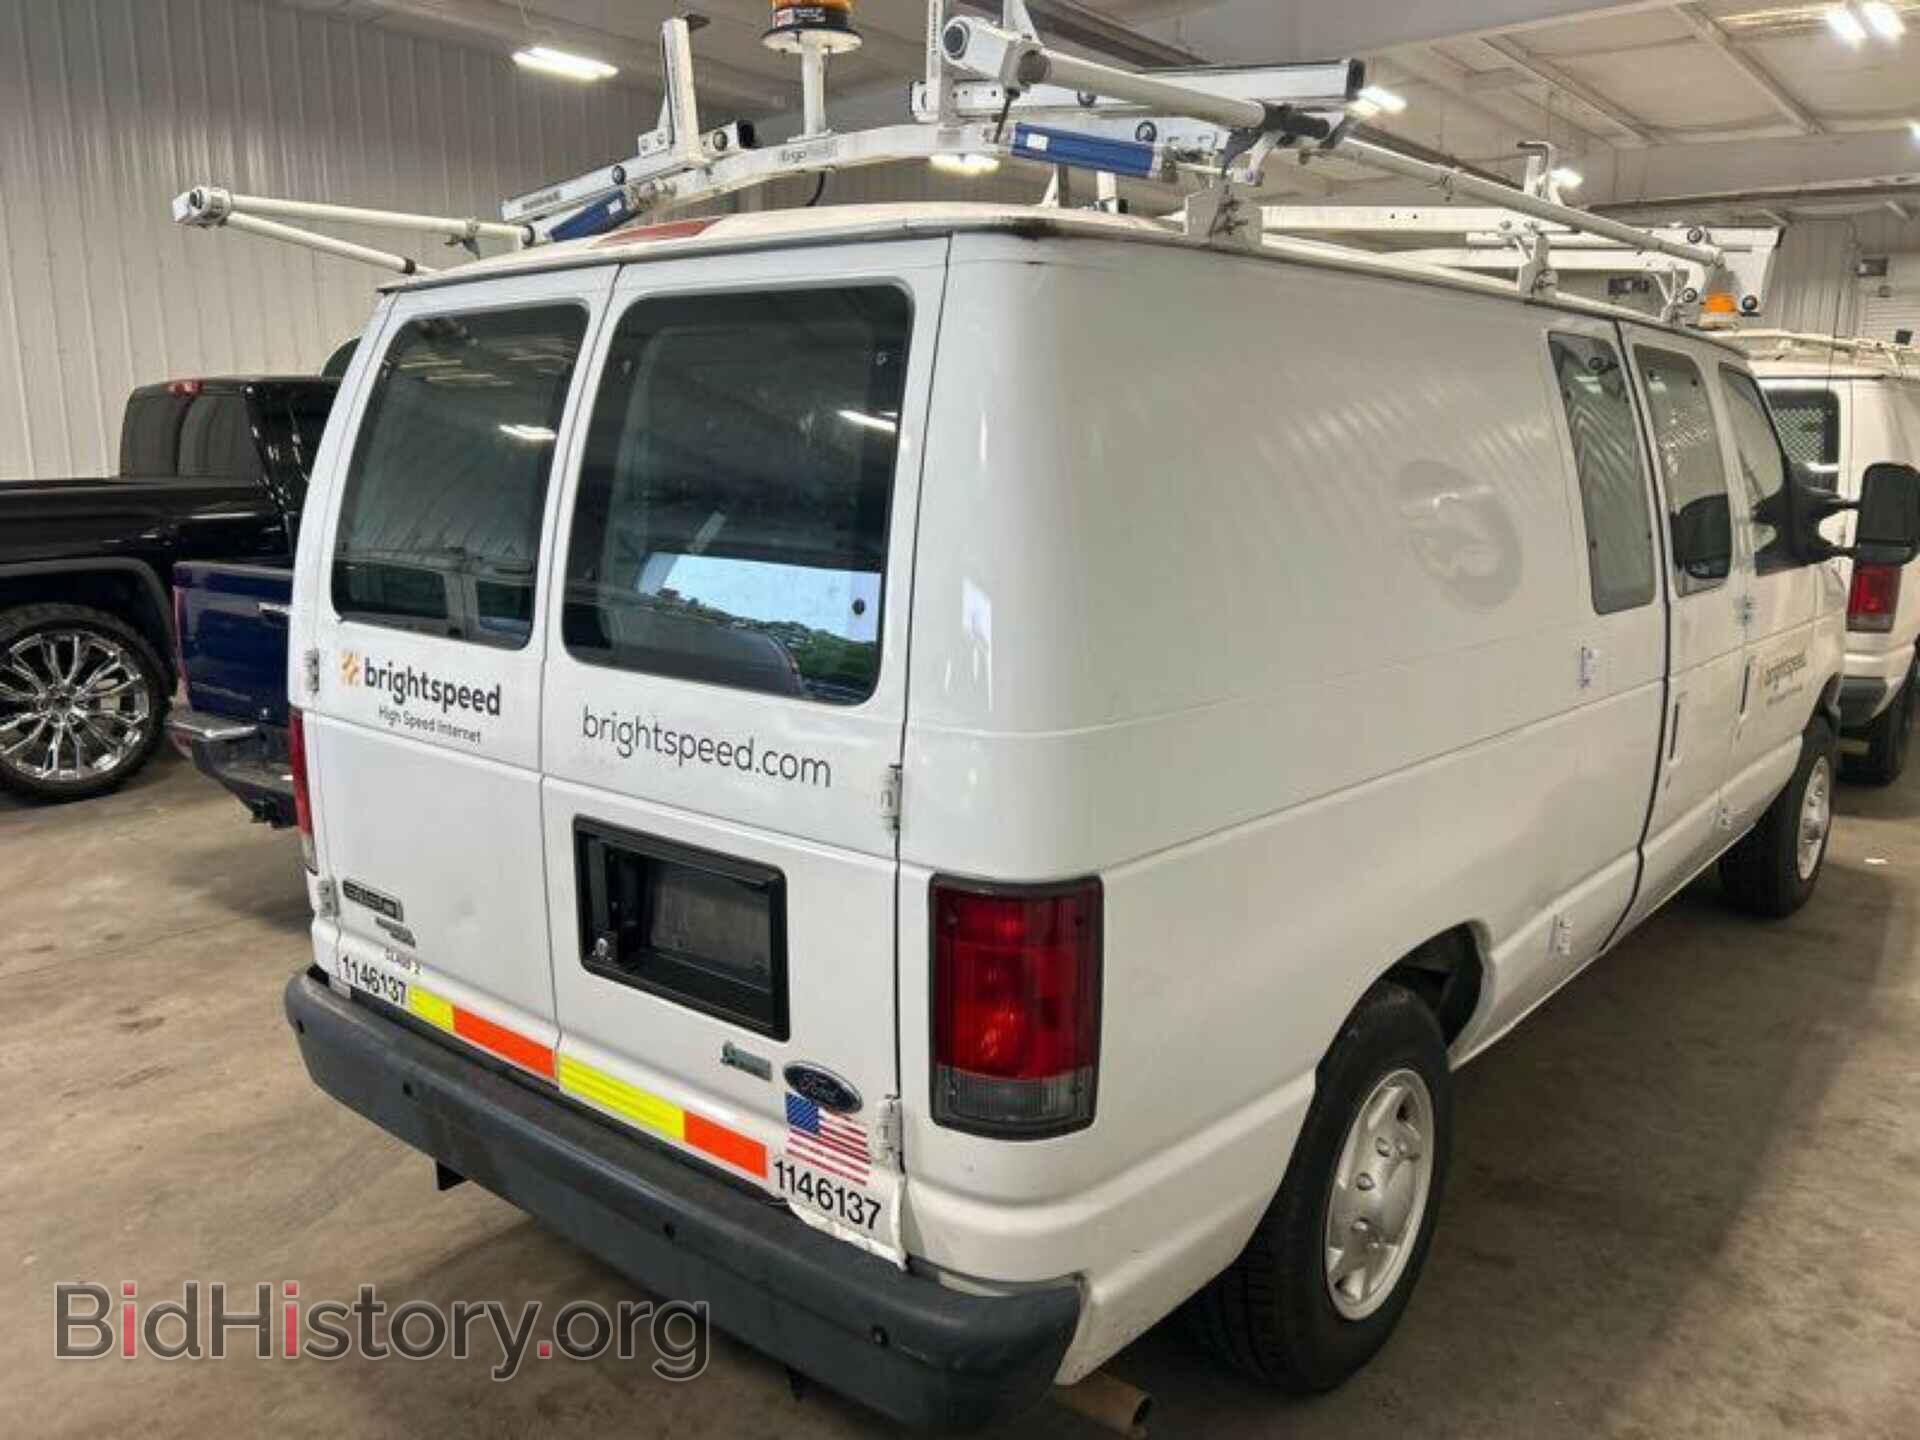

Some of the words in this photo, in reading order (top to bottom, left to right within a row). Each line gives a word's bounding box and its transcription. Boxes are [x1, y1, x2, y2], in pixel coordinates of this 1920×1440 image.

[364, 657, 501, 716] brightspeed
[379, 704, 402, 728] High
[403, 710, 435, 733] Speed
[437, 720, 481, 743] Internet
[582, 704, 831, 788] brightspeed.com
[342, 954, 406, 1005] 1146137
[774, 1160, 881, 1230] 1146137
